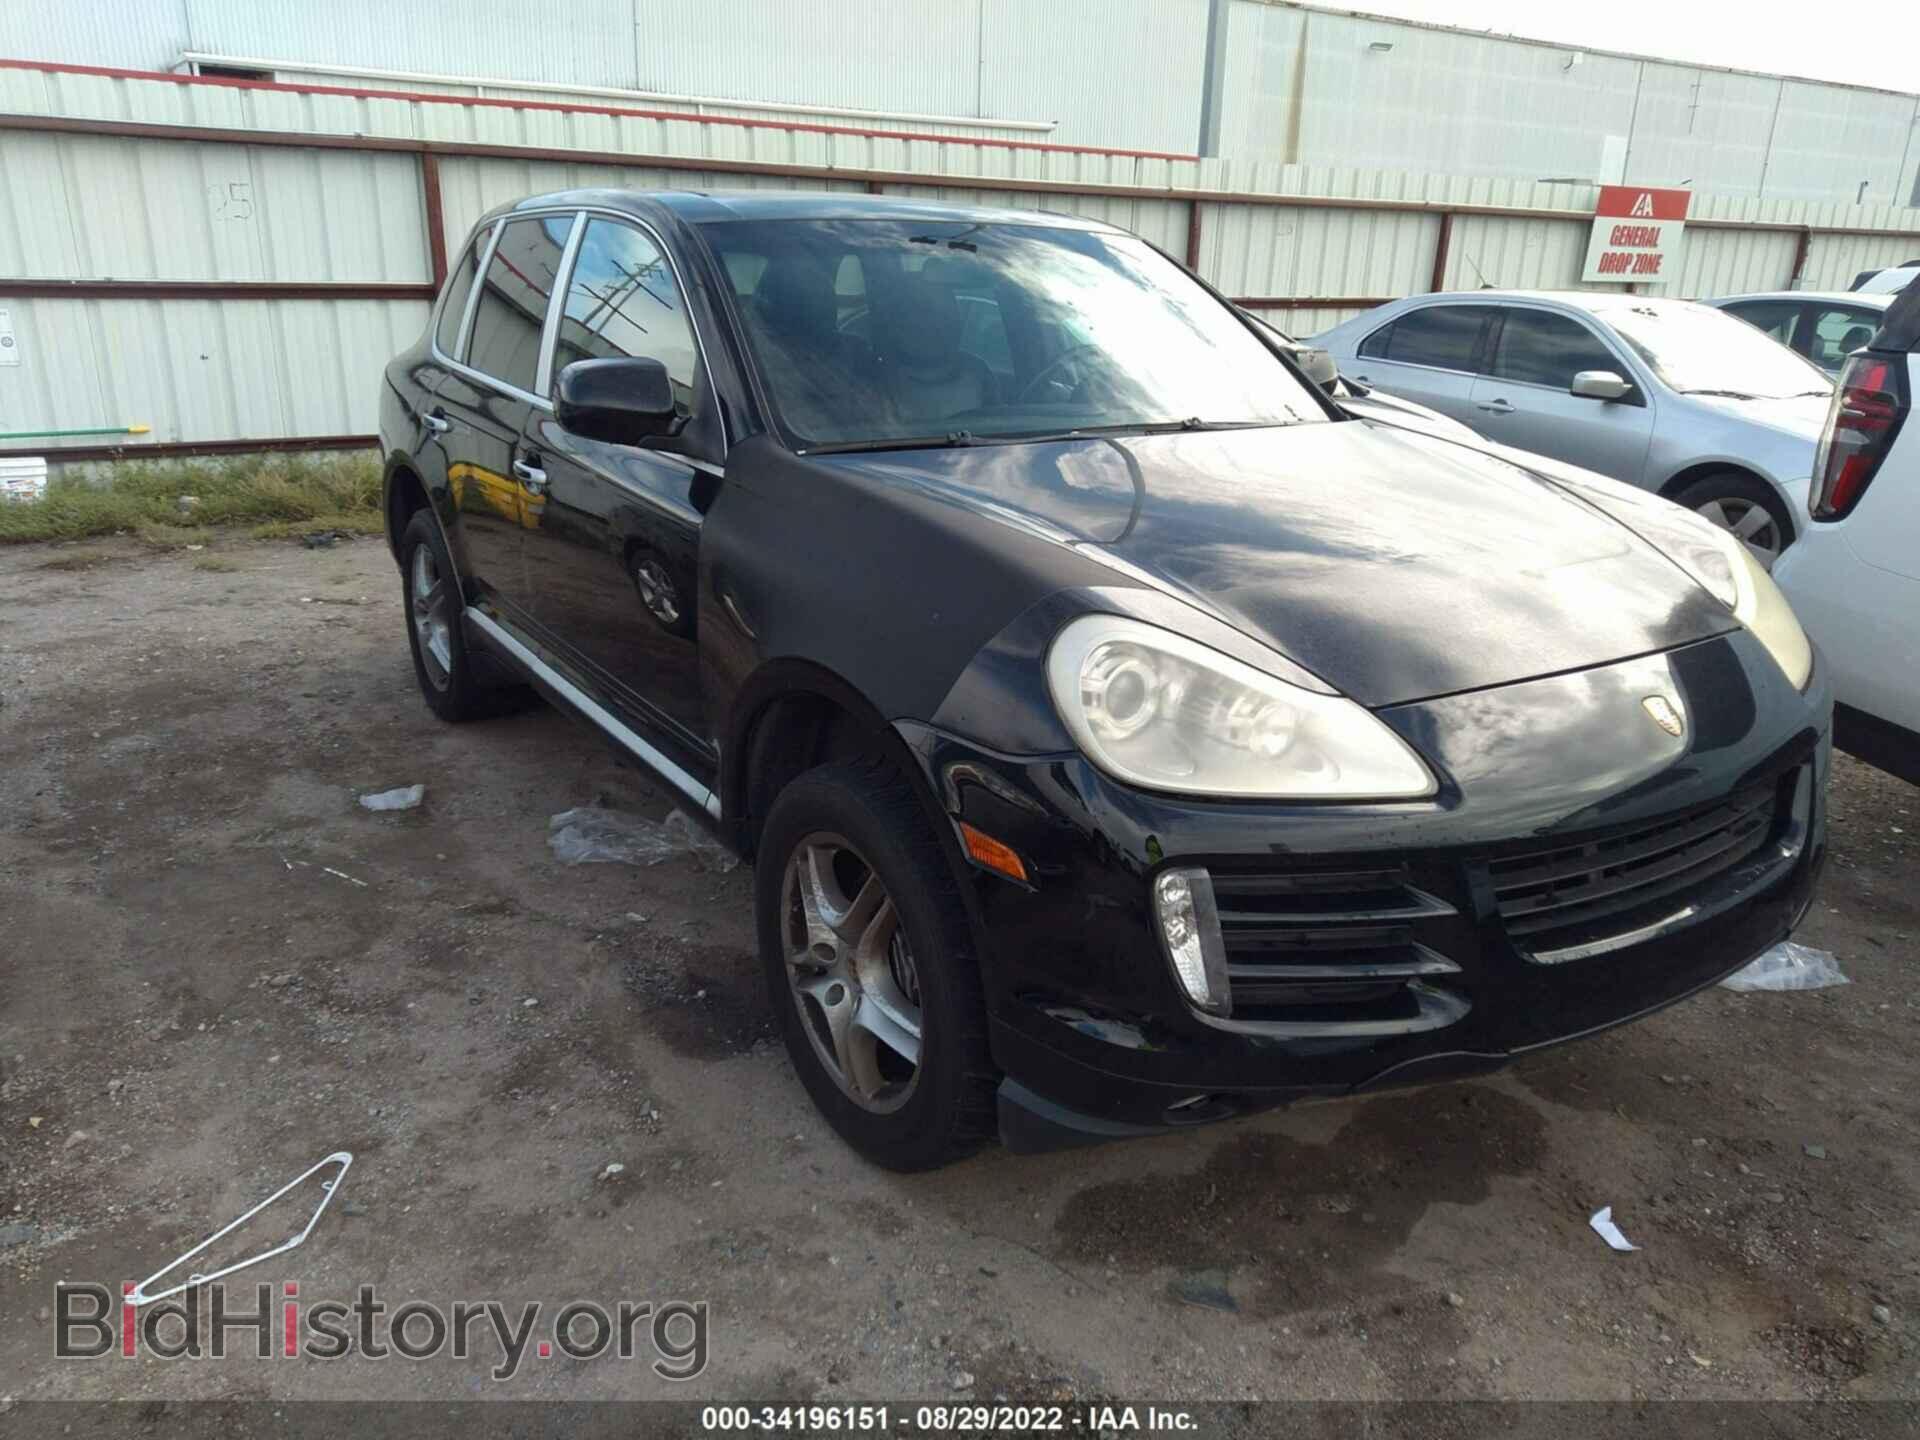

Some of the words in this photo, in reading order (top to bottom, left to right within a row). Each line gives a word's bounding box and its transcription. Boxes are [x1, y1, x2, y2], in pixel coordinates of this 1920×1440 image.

[1610, 224, 1661, 248] GENERAL
[1598, 252, 1632, 274] DROP
[1632, 253, 1664, 275] ZONE
